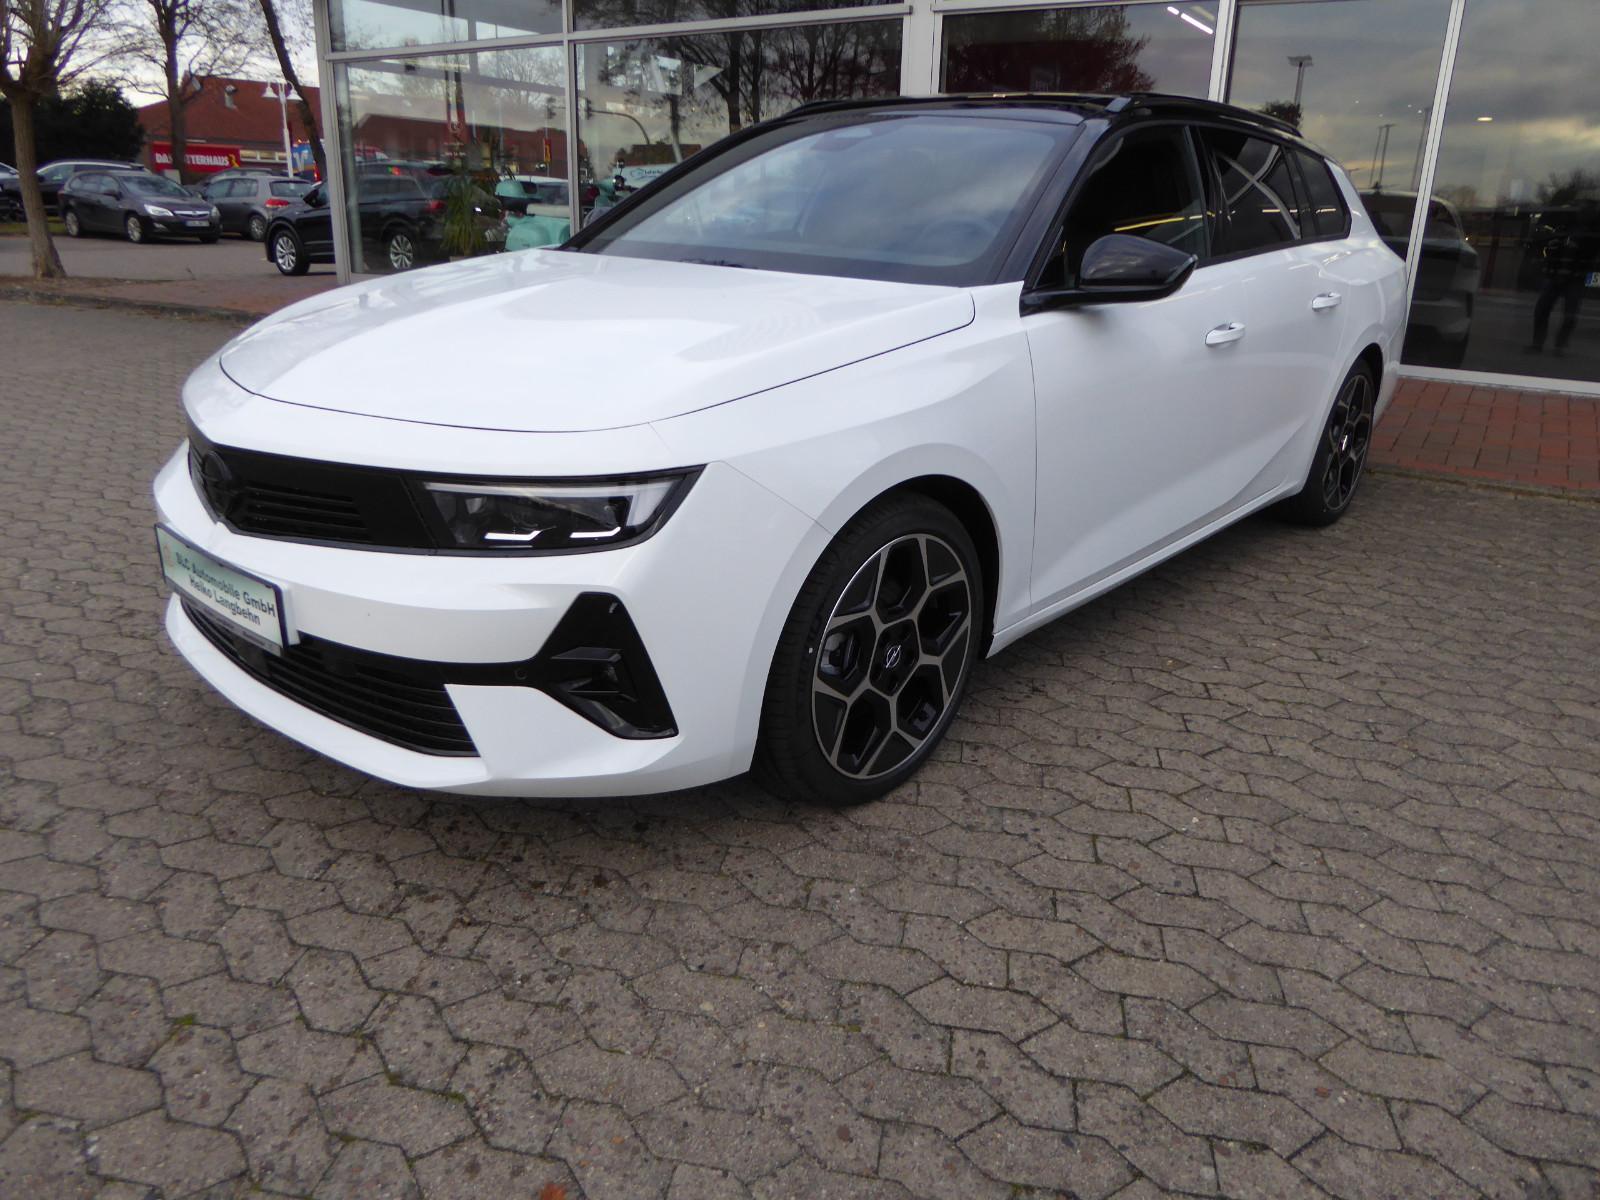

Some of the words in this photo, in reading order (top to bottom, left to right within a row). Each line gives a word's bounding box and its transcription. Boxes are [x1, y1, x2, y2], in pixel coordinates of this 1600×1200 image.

[192, 563, 240, 600] Automobile
[243, 591, 275, 618] GmbH
[214, 589, 261, 626] Langbehn
